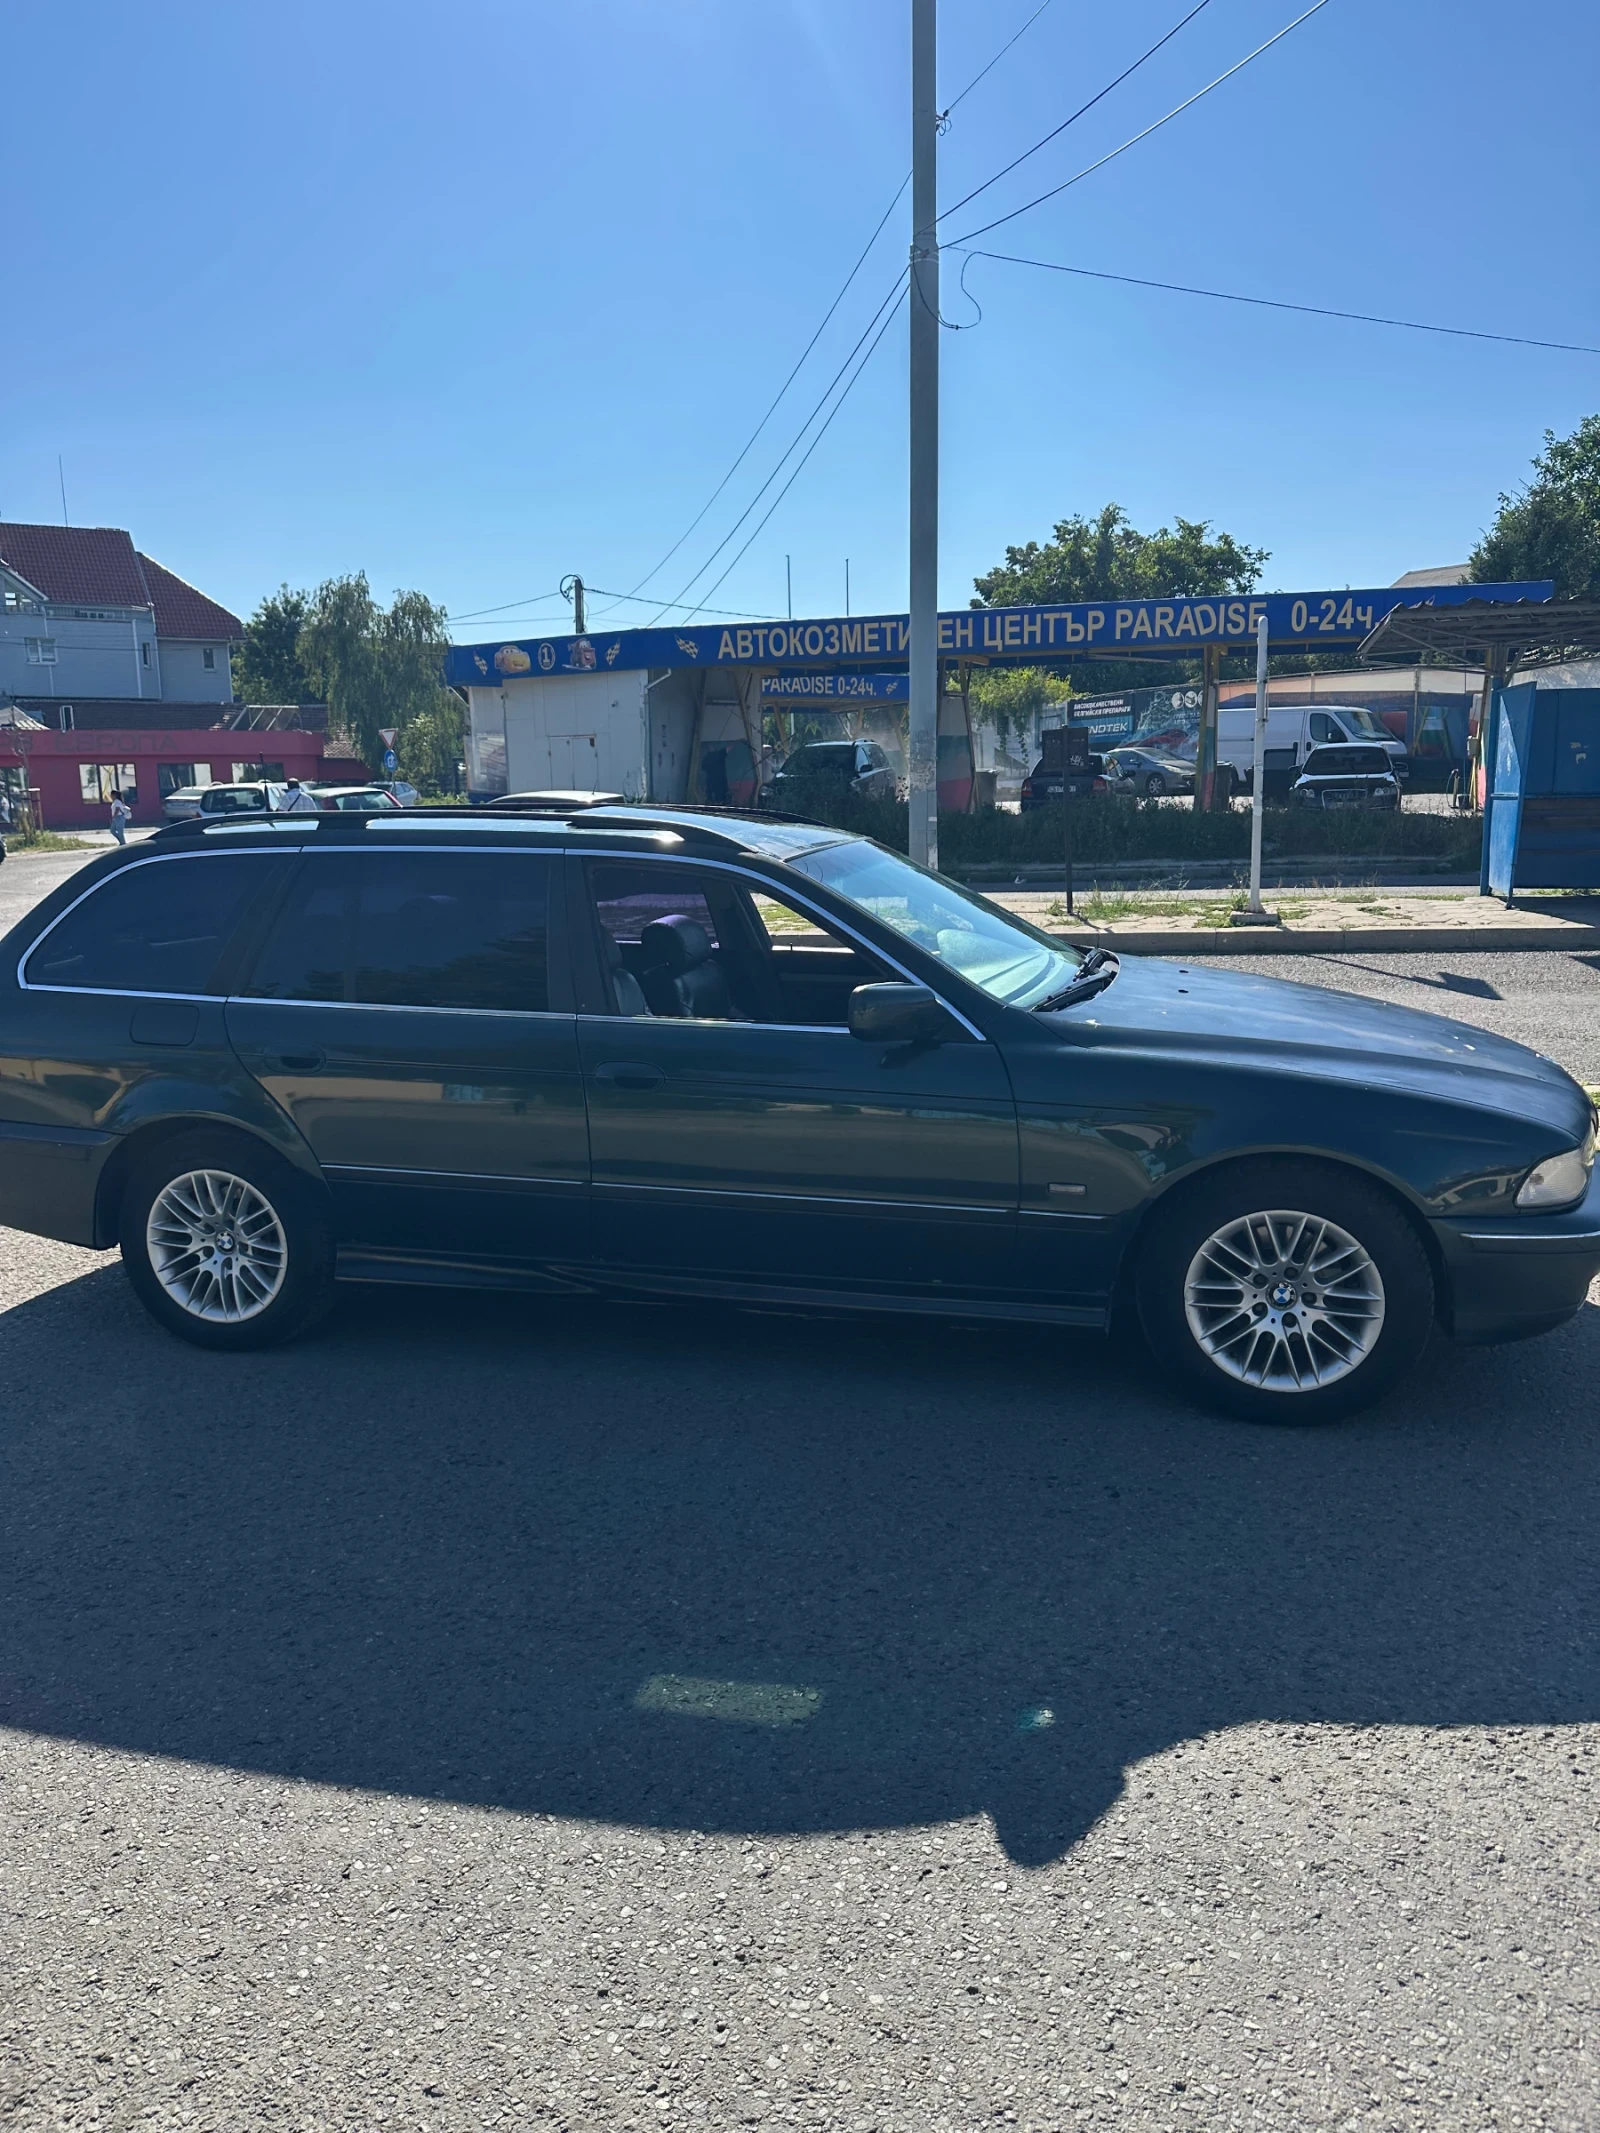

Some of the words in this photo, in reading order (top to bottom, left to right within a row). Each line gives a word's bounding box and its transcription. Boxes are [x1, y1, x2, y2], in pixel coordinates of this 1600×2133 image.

[717, 617, 973, 660] АВТОКОЗМЕТИЕН
[983, 610, 1105, 652] ЦЕНТЪР
[1115, 602, 1268, 639] PARADISE
[762, 676, 833, 694] PARADISE
[837, 676, 877, 696] 0-24ч.
